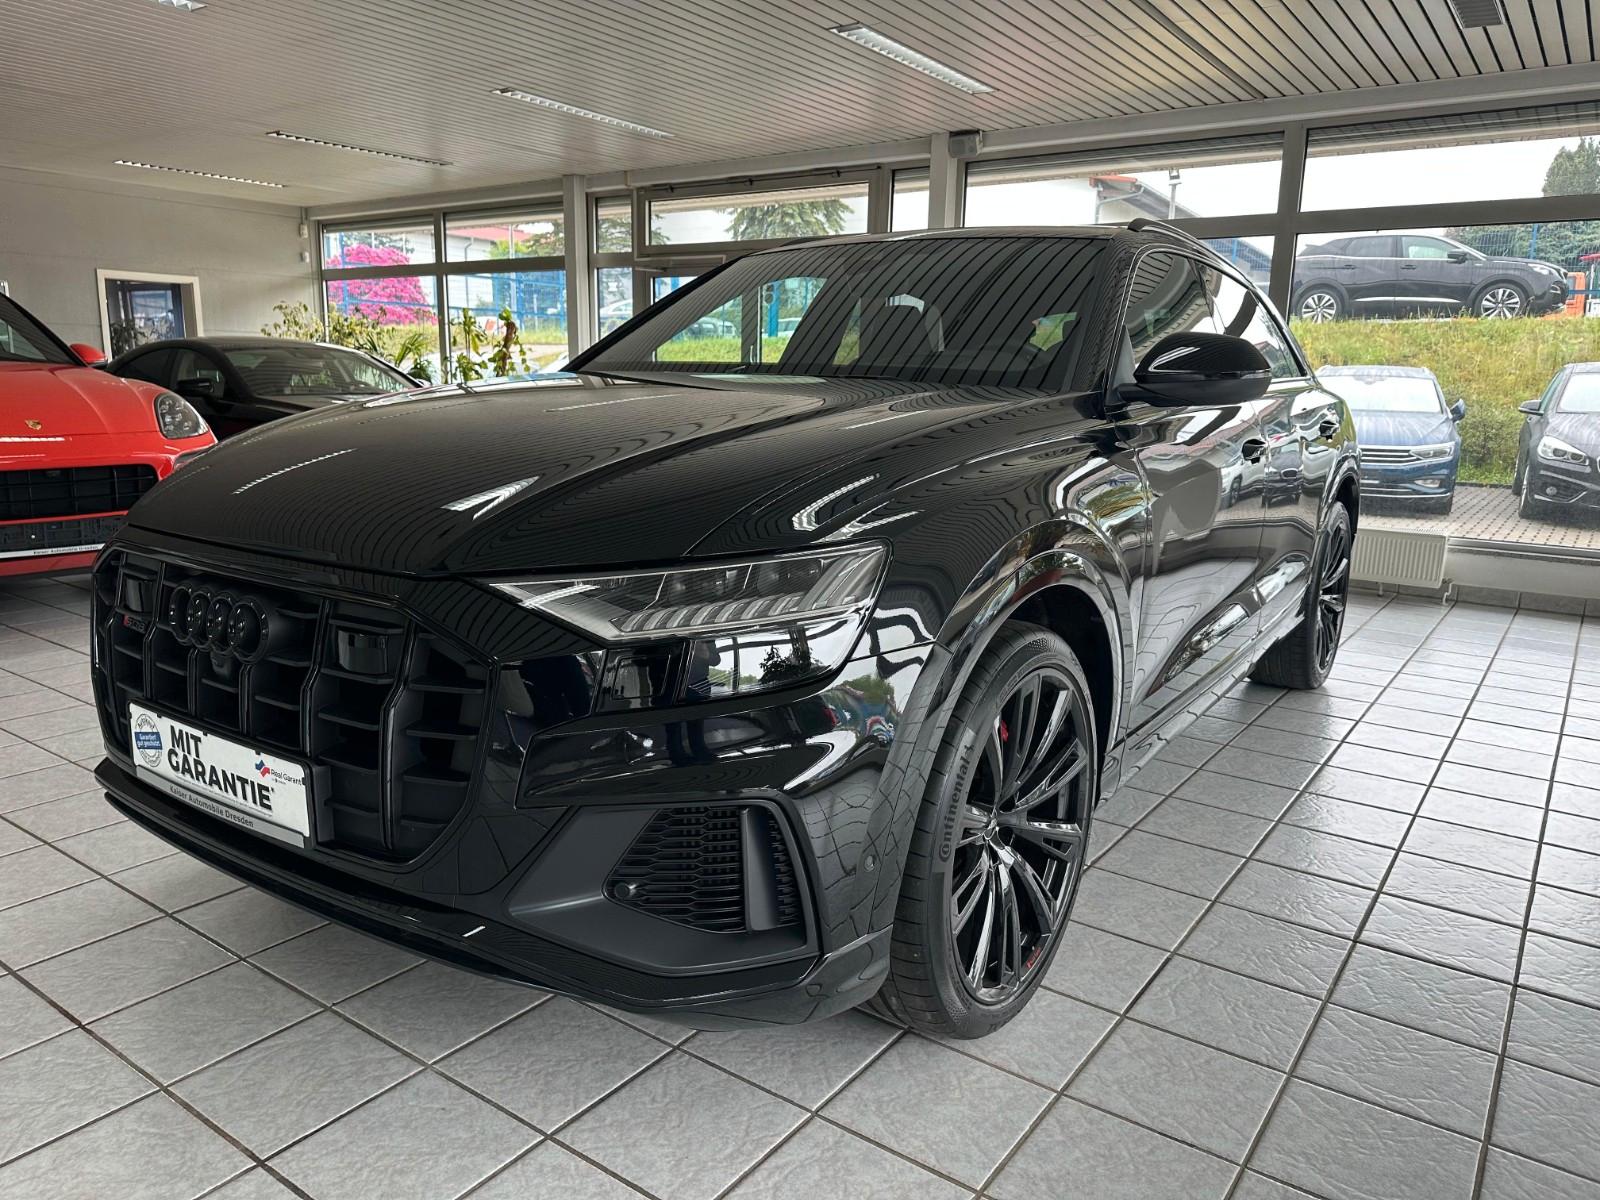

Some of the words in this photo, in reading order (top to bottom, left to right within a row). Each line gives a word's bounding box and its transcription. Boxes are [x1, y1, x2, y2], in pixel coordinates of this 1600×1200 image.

[170, 725, 202, 759] MIT
[169, 785, 187, 800] Kaiser
[188, 794, 224, 816] Automobile
[225, 809, 254, 828] Dresden
